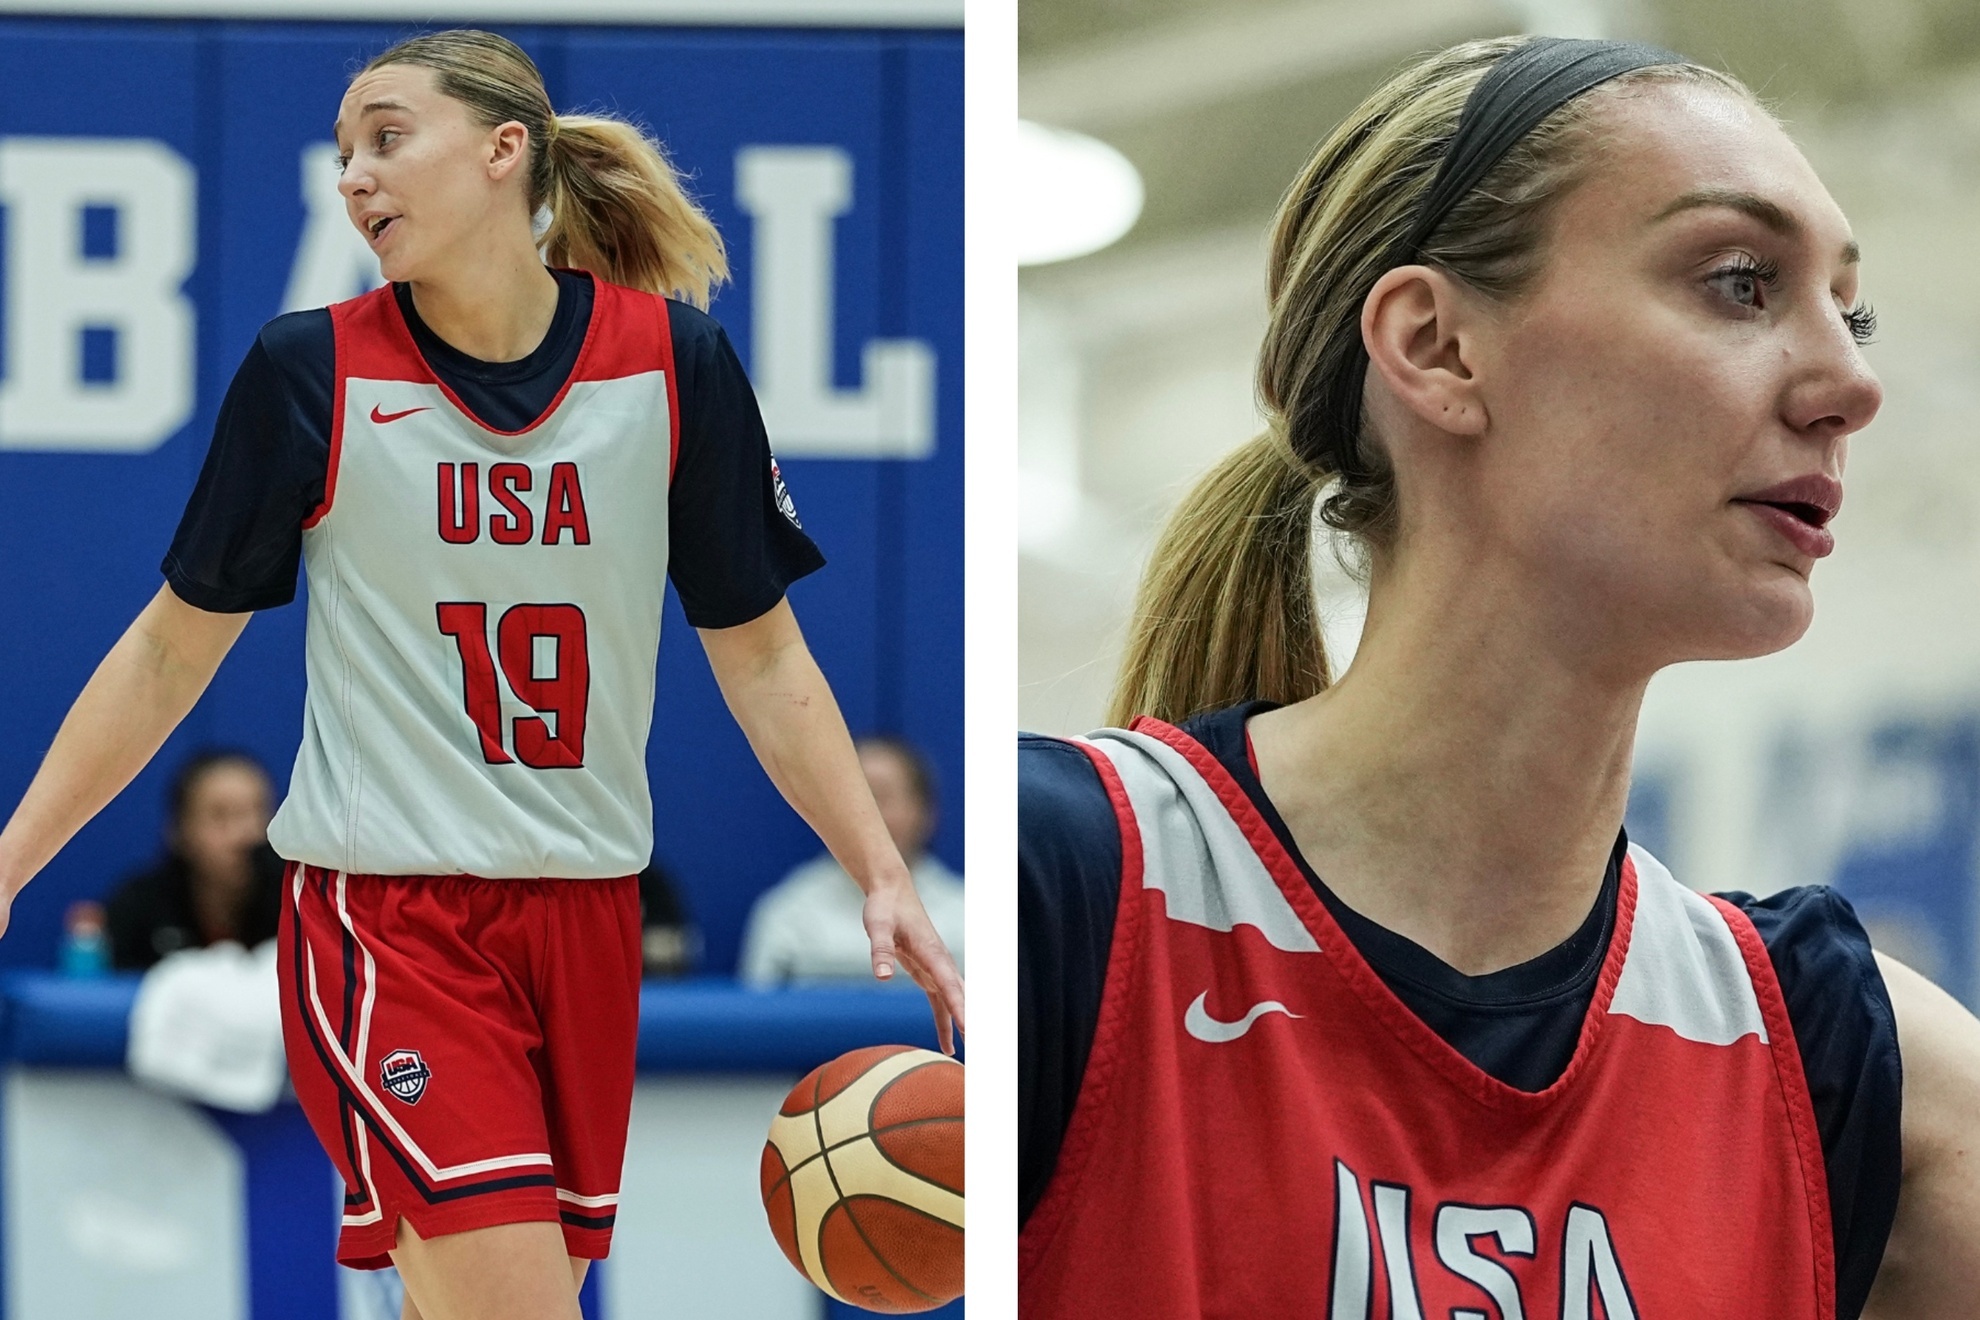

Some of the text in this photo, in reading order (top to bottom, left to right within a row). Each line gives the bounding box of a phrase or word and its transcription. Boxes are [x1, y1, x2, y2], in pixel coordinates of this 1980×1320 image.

[437, 462, 591, 545] USA
[436, 602, 590, 769] 19
[386, 1056, 418, 1076] USA
[1327, 1157, 1640, 1320] USA
